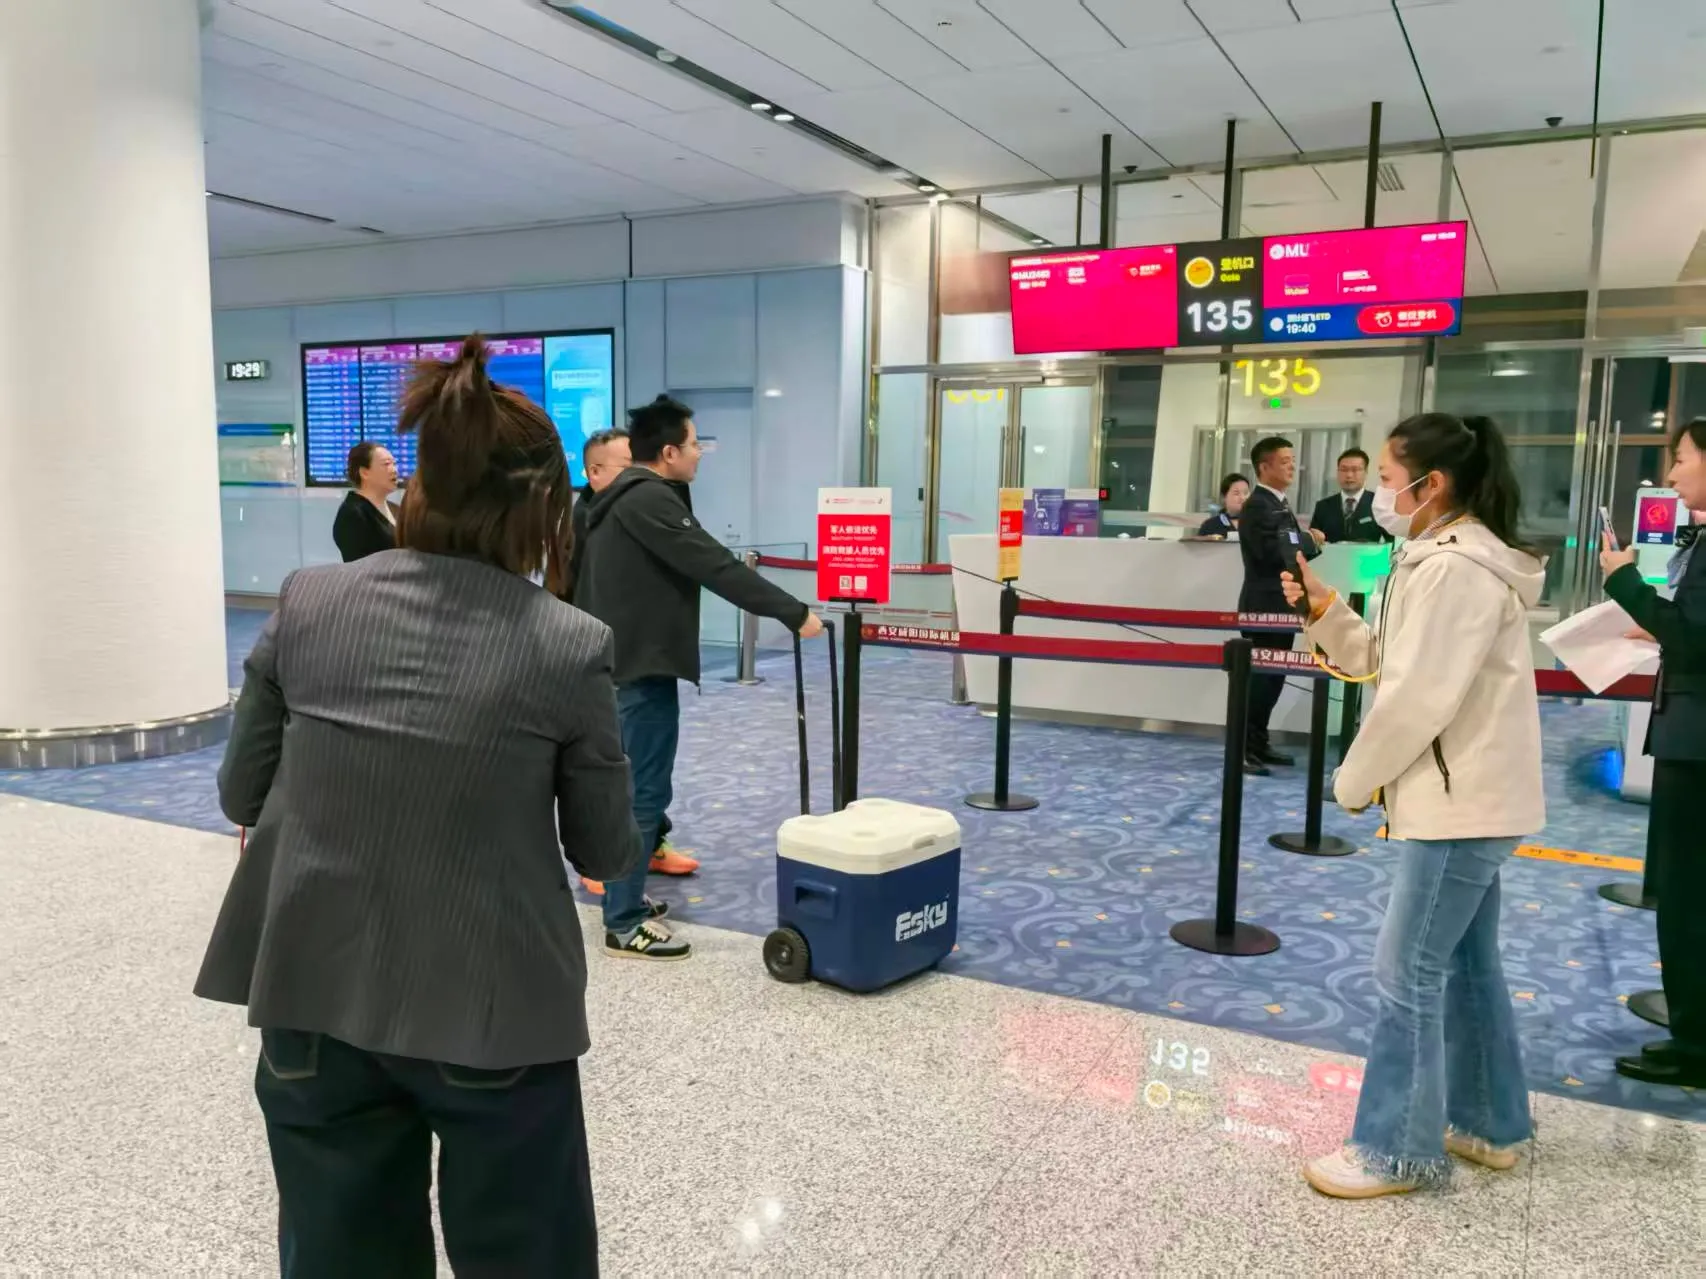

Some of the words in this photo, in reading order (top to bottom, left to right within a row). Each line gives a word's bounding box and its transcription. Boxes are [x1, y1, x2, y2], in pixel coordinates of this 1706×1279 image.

[1220, 257, 1255, 271] 登机口
[1186, 299, 1253, 333] 135
[1286, 323, 1317, 335] 19:40
[231, 362, 260, 378] 19:29
[1235, 358, 1321, 396] 135
[878, 626, 960, 642] 西安咸阳国际机场
